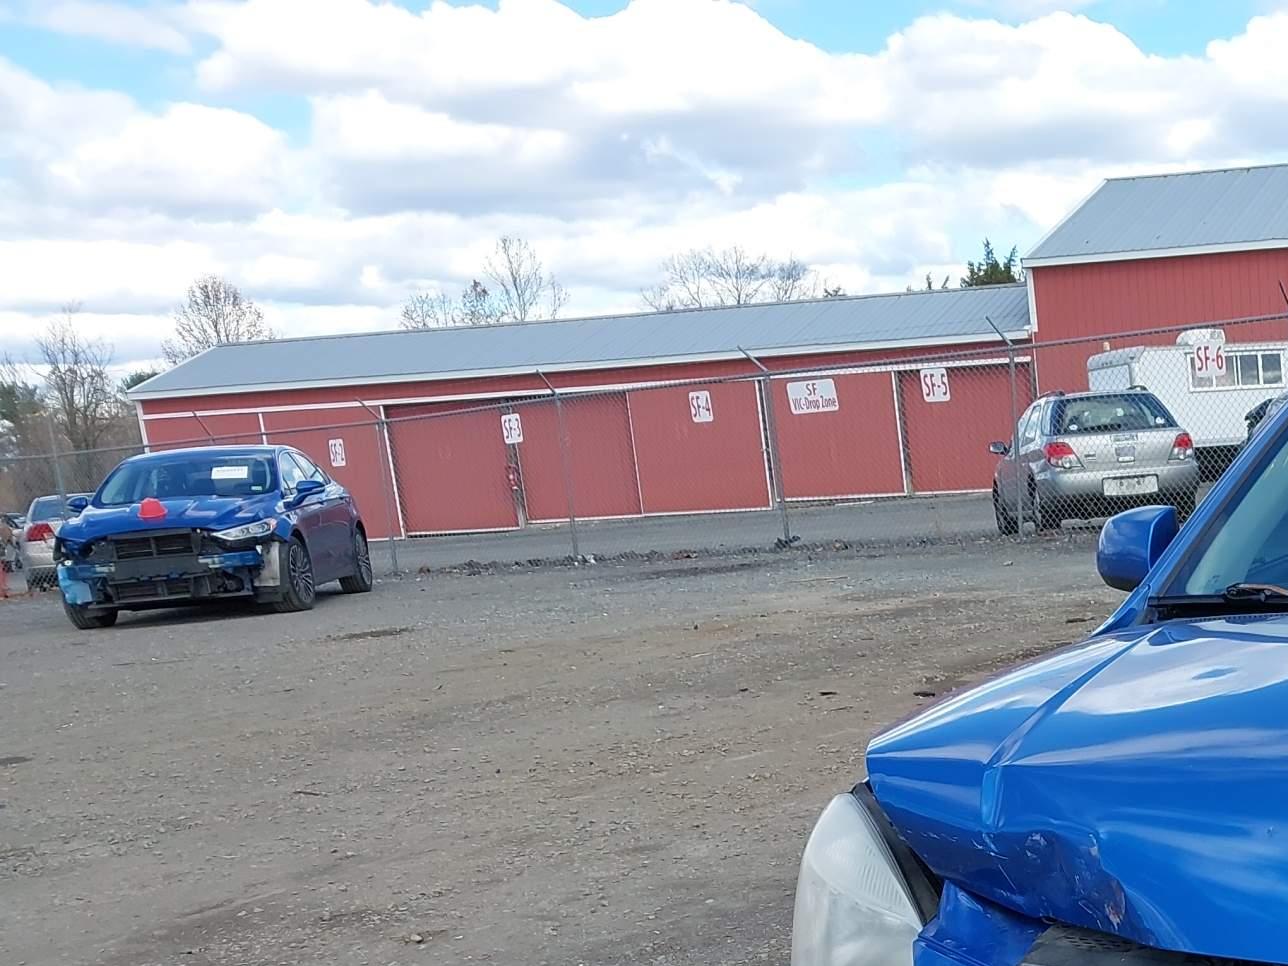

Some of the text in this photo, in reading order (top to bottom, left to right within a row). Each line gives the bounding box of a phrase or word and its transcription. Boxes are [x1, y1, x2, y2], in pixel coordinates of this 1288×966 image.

[1195, 345, 1223, 371] SF-6
[805, 382, 817, 396] SF
[923, 373, 948, 397] SF-5
[690, 395, 711, 417] SF-4
[819, 395, 837, 408] Zone
[503, 418, 521, 439] SF-3
